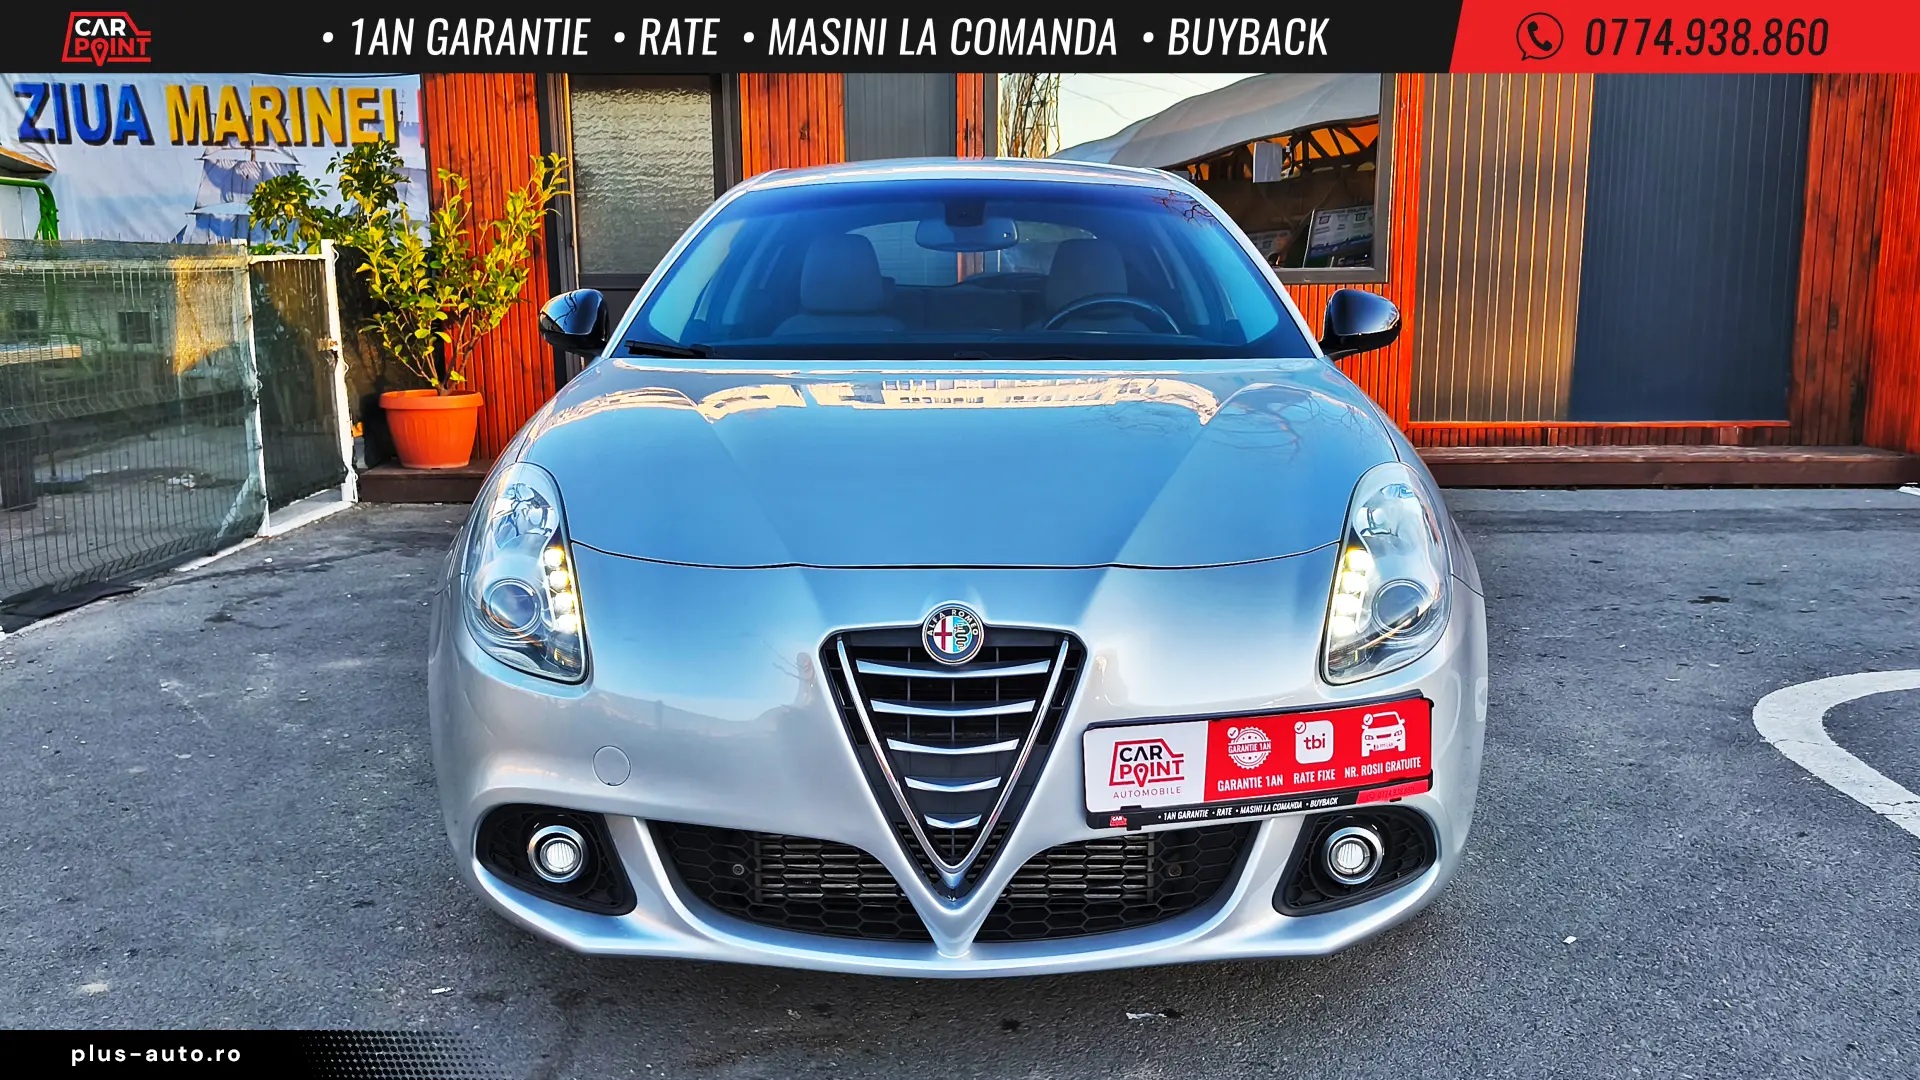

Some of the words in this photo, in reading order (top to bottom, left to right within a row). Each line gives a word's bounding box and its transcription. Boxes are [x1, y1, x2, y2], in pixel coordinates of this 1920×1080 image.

[14, 82, 152, 145] ZIUA
[165, 85, 400, 148] MARINEI
[927, 612, 946, 636] ALFA
[951, 609, 978, 636] ROMEO
[1228, 742, 1258, 754] GARANTIE
[1304, 733, 1326, 750] tbi
[1119, 745, 1163, 762] CAR
[1120, 759, 1184, 787] POINT
[1293, 771, 1315, 784] RATE
[1318, 768, 1336, 781] FIXE
[1344, 767, 1359, 778] NR.
[1361, 763, 1383, 776] ROSII
[1385, 757, 1422, 771] GRATUITE
[1217, 776, 1263, 791] GARANTIE
[1265, 774, 1284, 787] 1AN
[1113, 786, 1181, 799] AUTOMOBILE
[1163, 811, 1177, 821] 1AN
[1177, 809, 1209, 820] GARANTIE
[1216, 807, 1233, 816] RATE
[1240, 804, 1263, 814] MASINI
[1263, 803, 1271, 812] LA
[1272, 801, 1303, 811] COMANDA
[1309, 797, 1339, 808] BUYBACK
